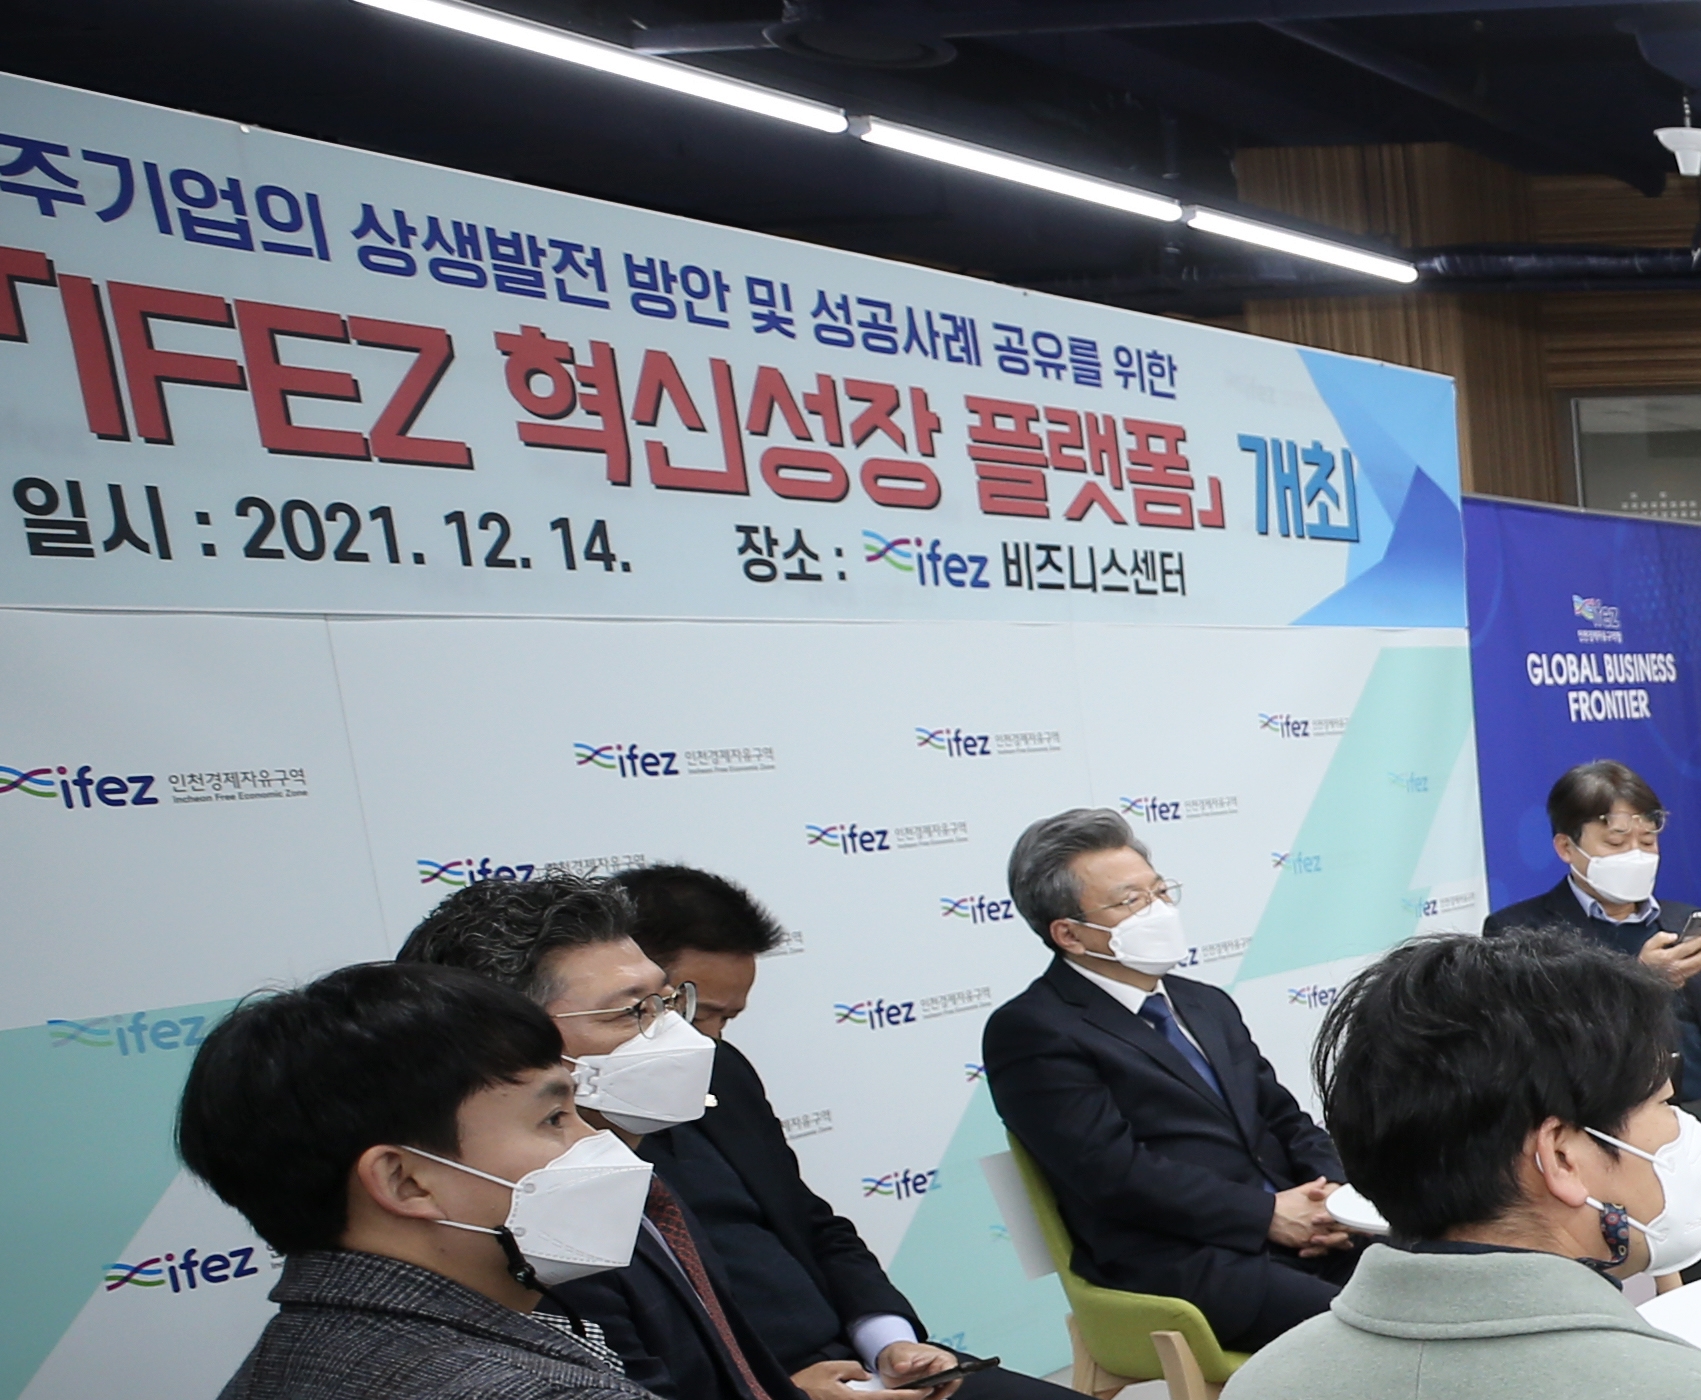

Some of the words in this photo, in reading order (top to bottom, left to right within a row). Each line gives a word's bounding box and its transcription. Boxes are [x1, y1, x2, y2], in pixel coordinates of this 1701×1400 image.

[0, 133, 331, 262] 주기업의
[351, 202, 611, 310] 상생발전
[622, 252, 731, 330] 방안
[746, 274, 797, 340] 및
[810, 288, 983, 367] 성공사례
[992, 321, 1104, 389] 공유를
[1113, 345, 1178, 399] 위한
[493, 322, 942, 510] 혁신성장
[1236, 431, 1361, 544] 개최
[12, 476, 173, 561] 일시
[195, 510, 218, 559] :
[234, 495, 426, 567] 2021.
[443, 509, 533, 571] 12.
[549, 517, 632, 573] 14.
[735, 522, 823, 584] 장소
[834, 547, 847, 582] :
[914, 536, 990, 590] ifez
[1001, 540, 1187, 597] 비즈니스센터
[1526, 652, 1603, 687] GLOBAL
[1603, 652, 1678, 685] BUSINESS
[1567, 688, 1651, 723] FRONTIER
[1278, 714, 1311, 739] ifez
[684, 747, 775, 768] 인천경제자유구역
[945, 729, 992, 758] ifez
[615, 743, 679, 779] ifez
[56, 765, 160, 809] ifez
[168, 768, 307, 792] 인천경제자유구역
[172, 795, 213, 804] Incheon
[215, 793, 236, 801] Free
[238, 790, 284, 800] Economic
[285, 788, 308, 798] Zone
[1144, 796, 1181, 823] ifez
[840, 824, 890, 855] ifez
[970, 895, 1014, 924] ifez
[867, 999, 917, 1031] ifez
[114, 1011, 205, 1057] ifez
[894, 1168, 941, 1200] ifez
[165, 1246, 259, 1294] ifez
